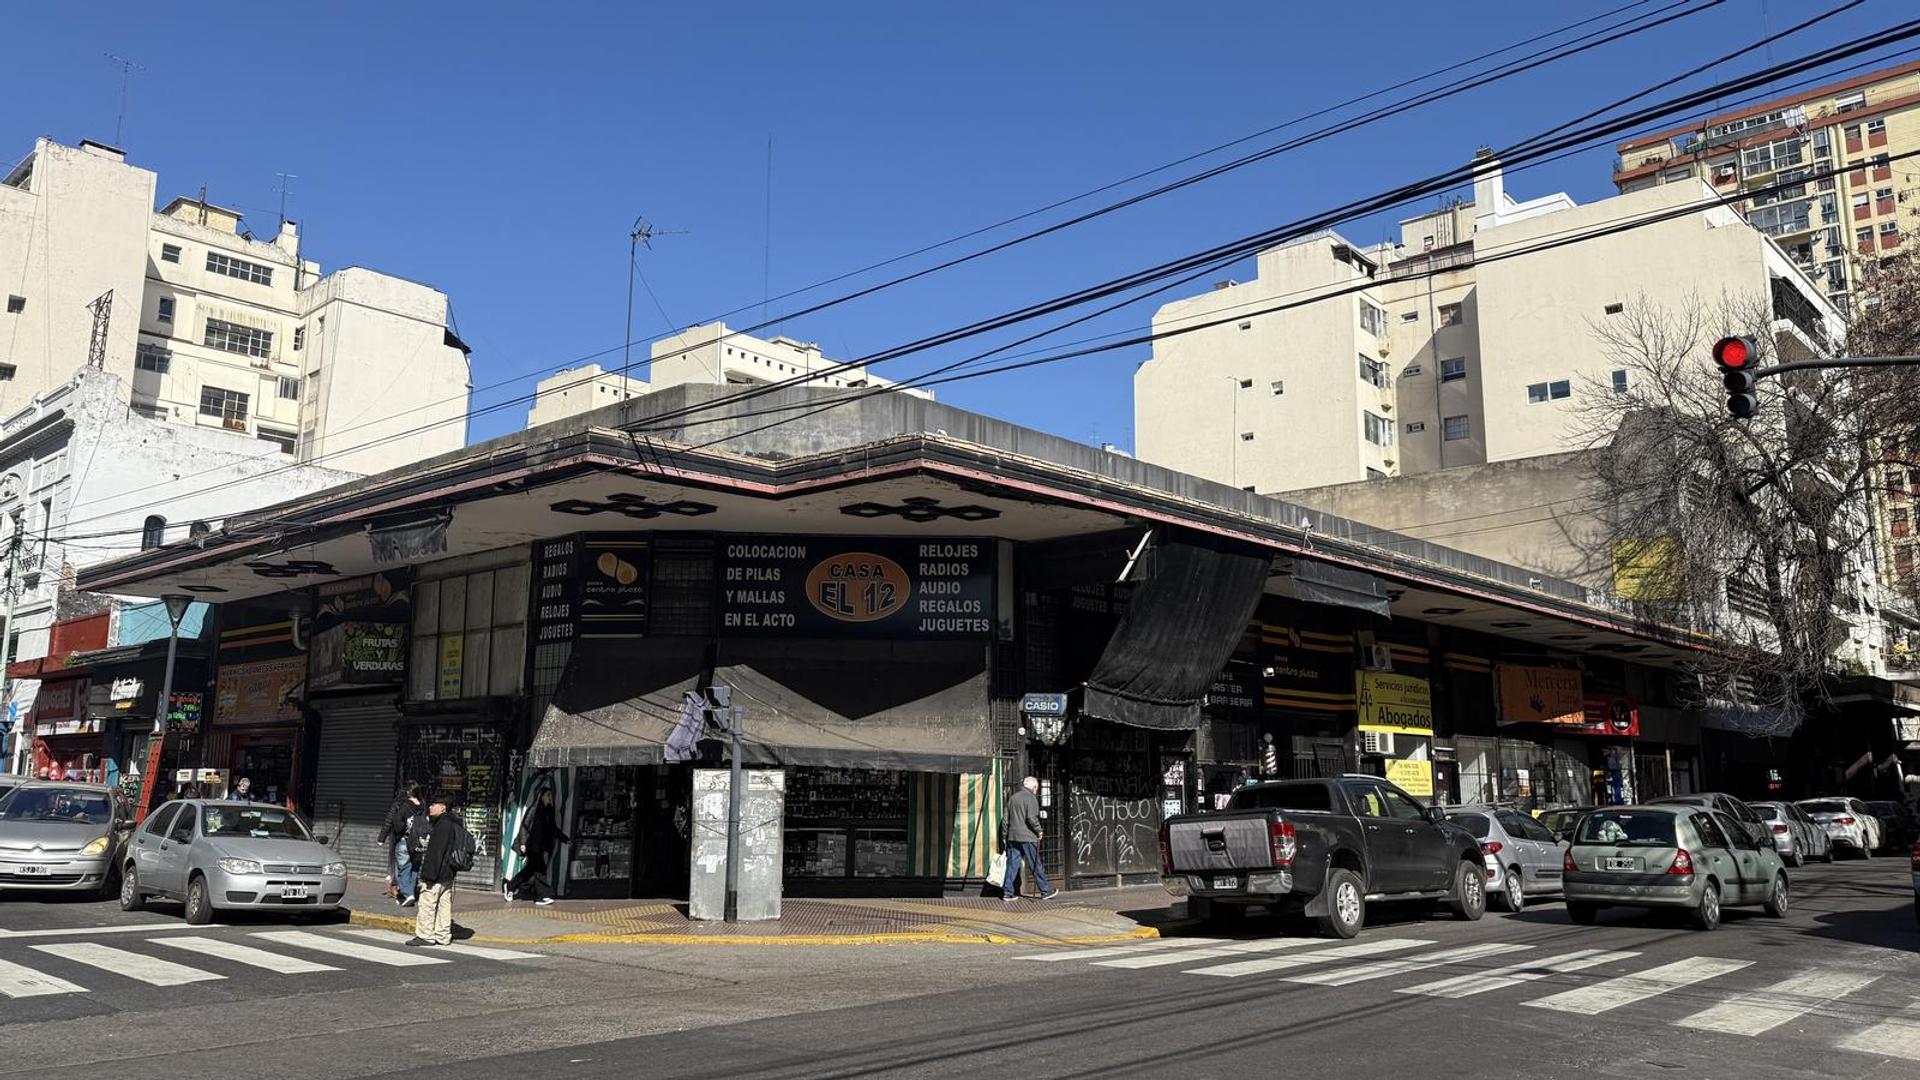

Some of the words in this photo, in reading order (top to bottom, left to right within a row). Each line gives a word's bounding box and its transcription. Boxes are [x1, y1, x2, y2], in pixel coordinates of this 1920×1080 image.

[544, 541, 574, 558] REGALOS
[727, 545, 806, 559] COLOCACION
[919, 544, 978, 558] RELOJES
[543, 563, 568, 578] RADIOS
[726, 568, 744, 581] DE
[745, 567, 781, 581] PILAS
[830, 564, 884, 578] CASA
[919, 563, 969, 576] RADIOS
[542, 583, 562, 599] AUDIO
[919, 582, 961, 594] AUDIO
[726, 590, 735, 603] Y
[737, 590, 785, 604] MALLAS
[819, 581, 855, 615] EL
[864, 581, 897, 614] 12
[540, 603, 570, 619] RELOJES
[919, 600, 981, 613] REGALOS
[724, 613, 741, 627] EN
[745, 613, 760, 627] EL
[763, 613, 795, 627] ACTO
[919, 618, 990, 632] JUGUETES
[539, 623, 574, 640] JUGUETES
[363, 639, 399, 648] FRUTAS
[376, 650, 384, 659] Y
[353, 661, 405, 671] VERDURAS
[1212, 683, 1243, 693] ASTER
[1375, 678, 1403, 692] Servicios
[1025, 701, 1059, 711] CASIO
[1378, 706, 1431, 729] Abogados
